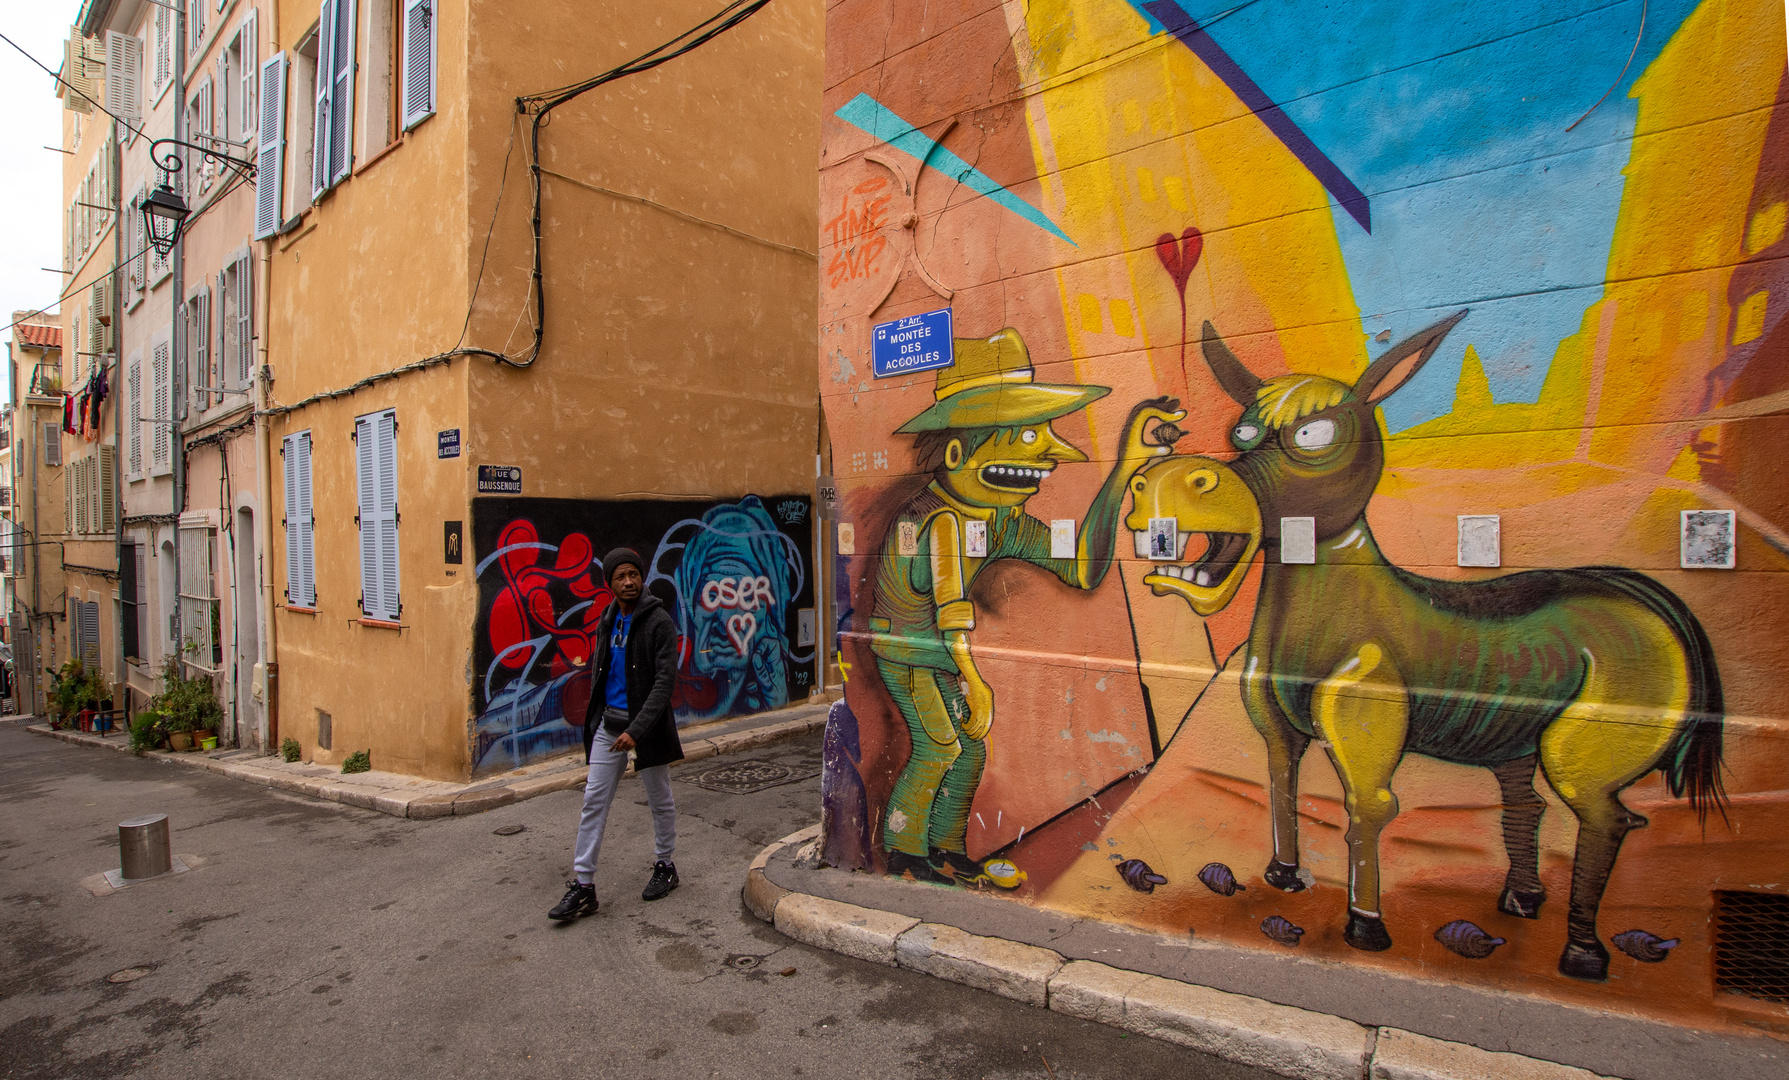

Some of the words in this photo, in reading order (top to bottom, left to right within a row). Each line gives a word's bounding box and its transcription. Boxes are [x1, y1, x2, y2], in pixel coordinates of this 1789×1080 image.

[890, 326, 932, 344] MONTÉE
[901, 342, 921, 354] DES
[886, 351, 940, 370] ACCOULES
[491, 469, 508, 478] RUE
